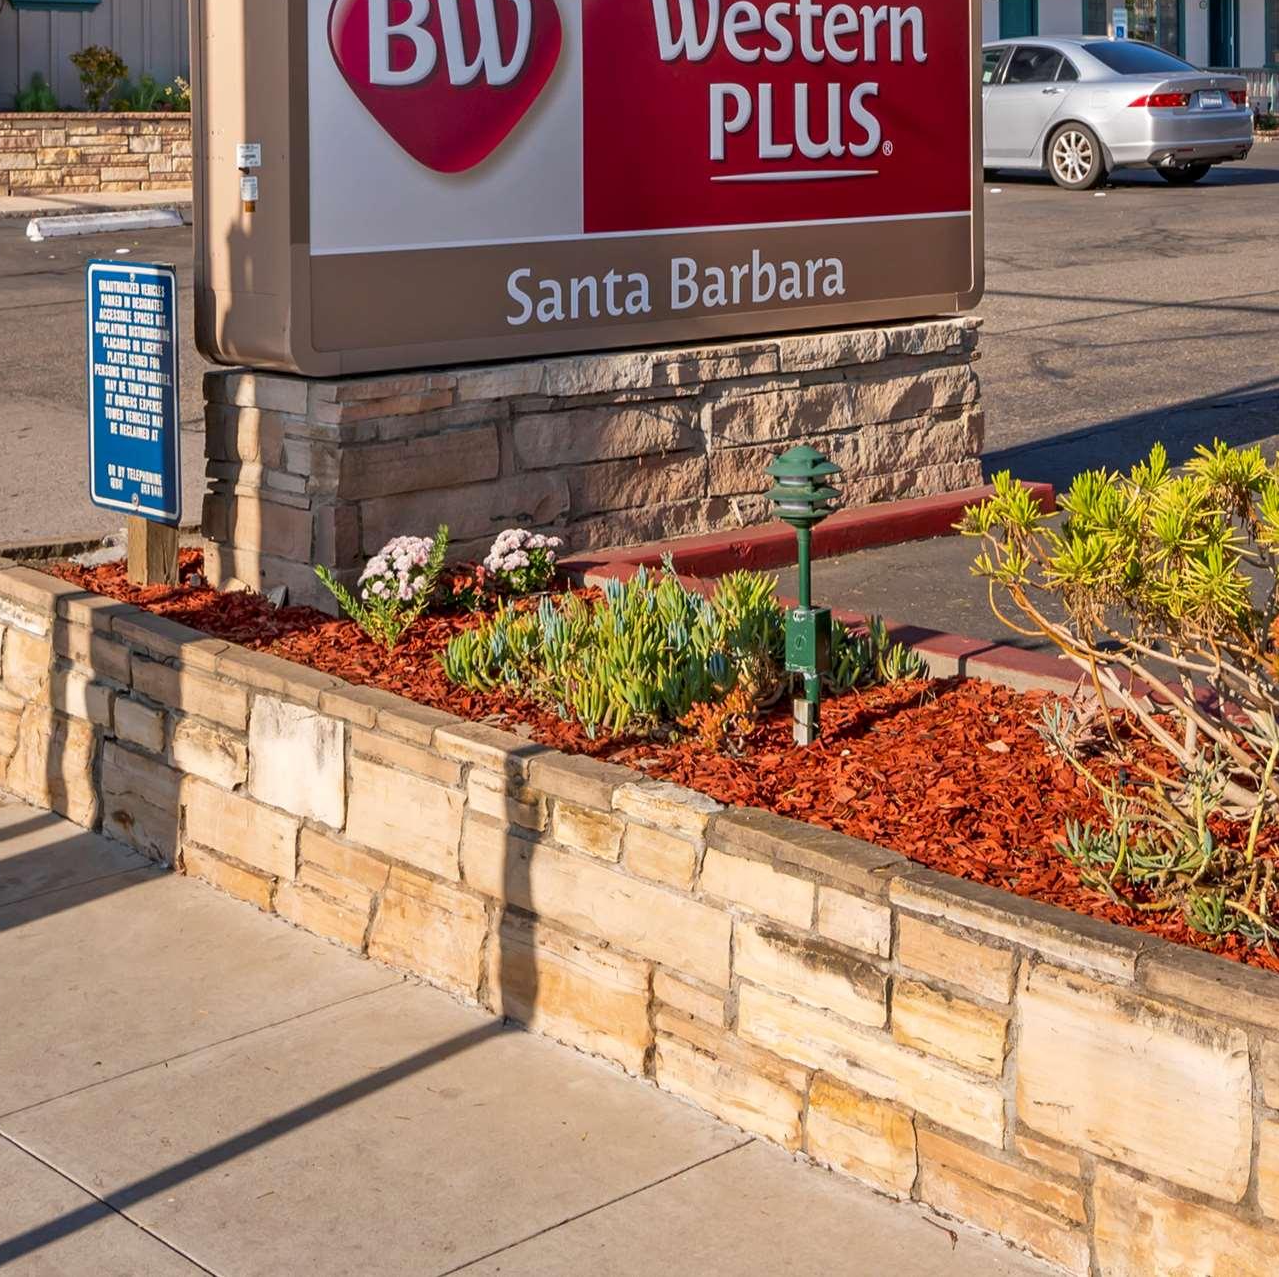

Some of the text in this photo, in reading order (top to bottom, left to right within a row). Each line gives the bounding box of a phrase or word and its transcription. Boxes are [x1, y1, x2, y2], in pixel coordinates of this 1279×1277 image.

[141, 283, 165, 298] VEHICLES
[506, 249, 846, 326] Santa Barbara
[101, 294, 122, 307] PARKED
[99, 307, 132, 322] ACCESSIBLE
[134, 311, 154, 325] SPACES
[95, 321, 127, 336] DISPLAYING
[103, 336, 131, 351] PLACARDS
[133, 339, 140, 353] OR
[107, 351, 127, 365] PLATES
[150, 356, 160, 370] FOR
[95, 363, 120, 378] PERSONS
[121, 366, 135, 381] WITH
[105, 379, 163, 400] MAY BE TOWED AWAY
[105, 393, 113, 405] AT
[105, 406, 163, 428] TOWED VEHICLES MAY
[110, 422, 158, 442] BE RECLAIMED AT
[108, 463, 116, 477] OR
[117, 465, 125, 478] BY
